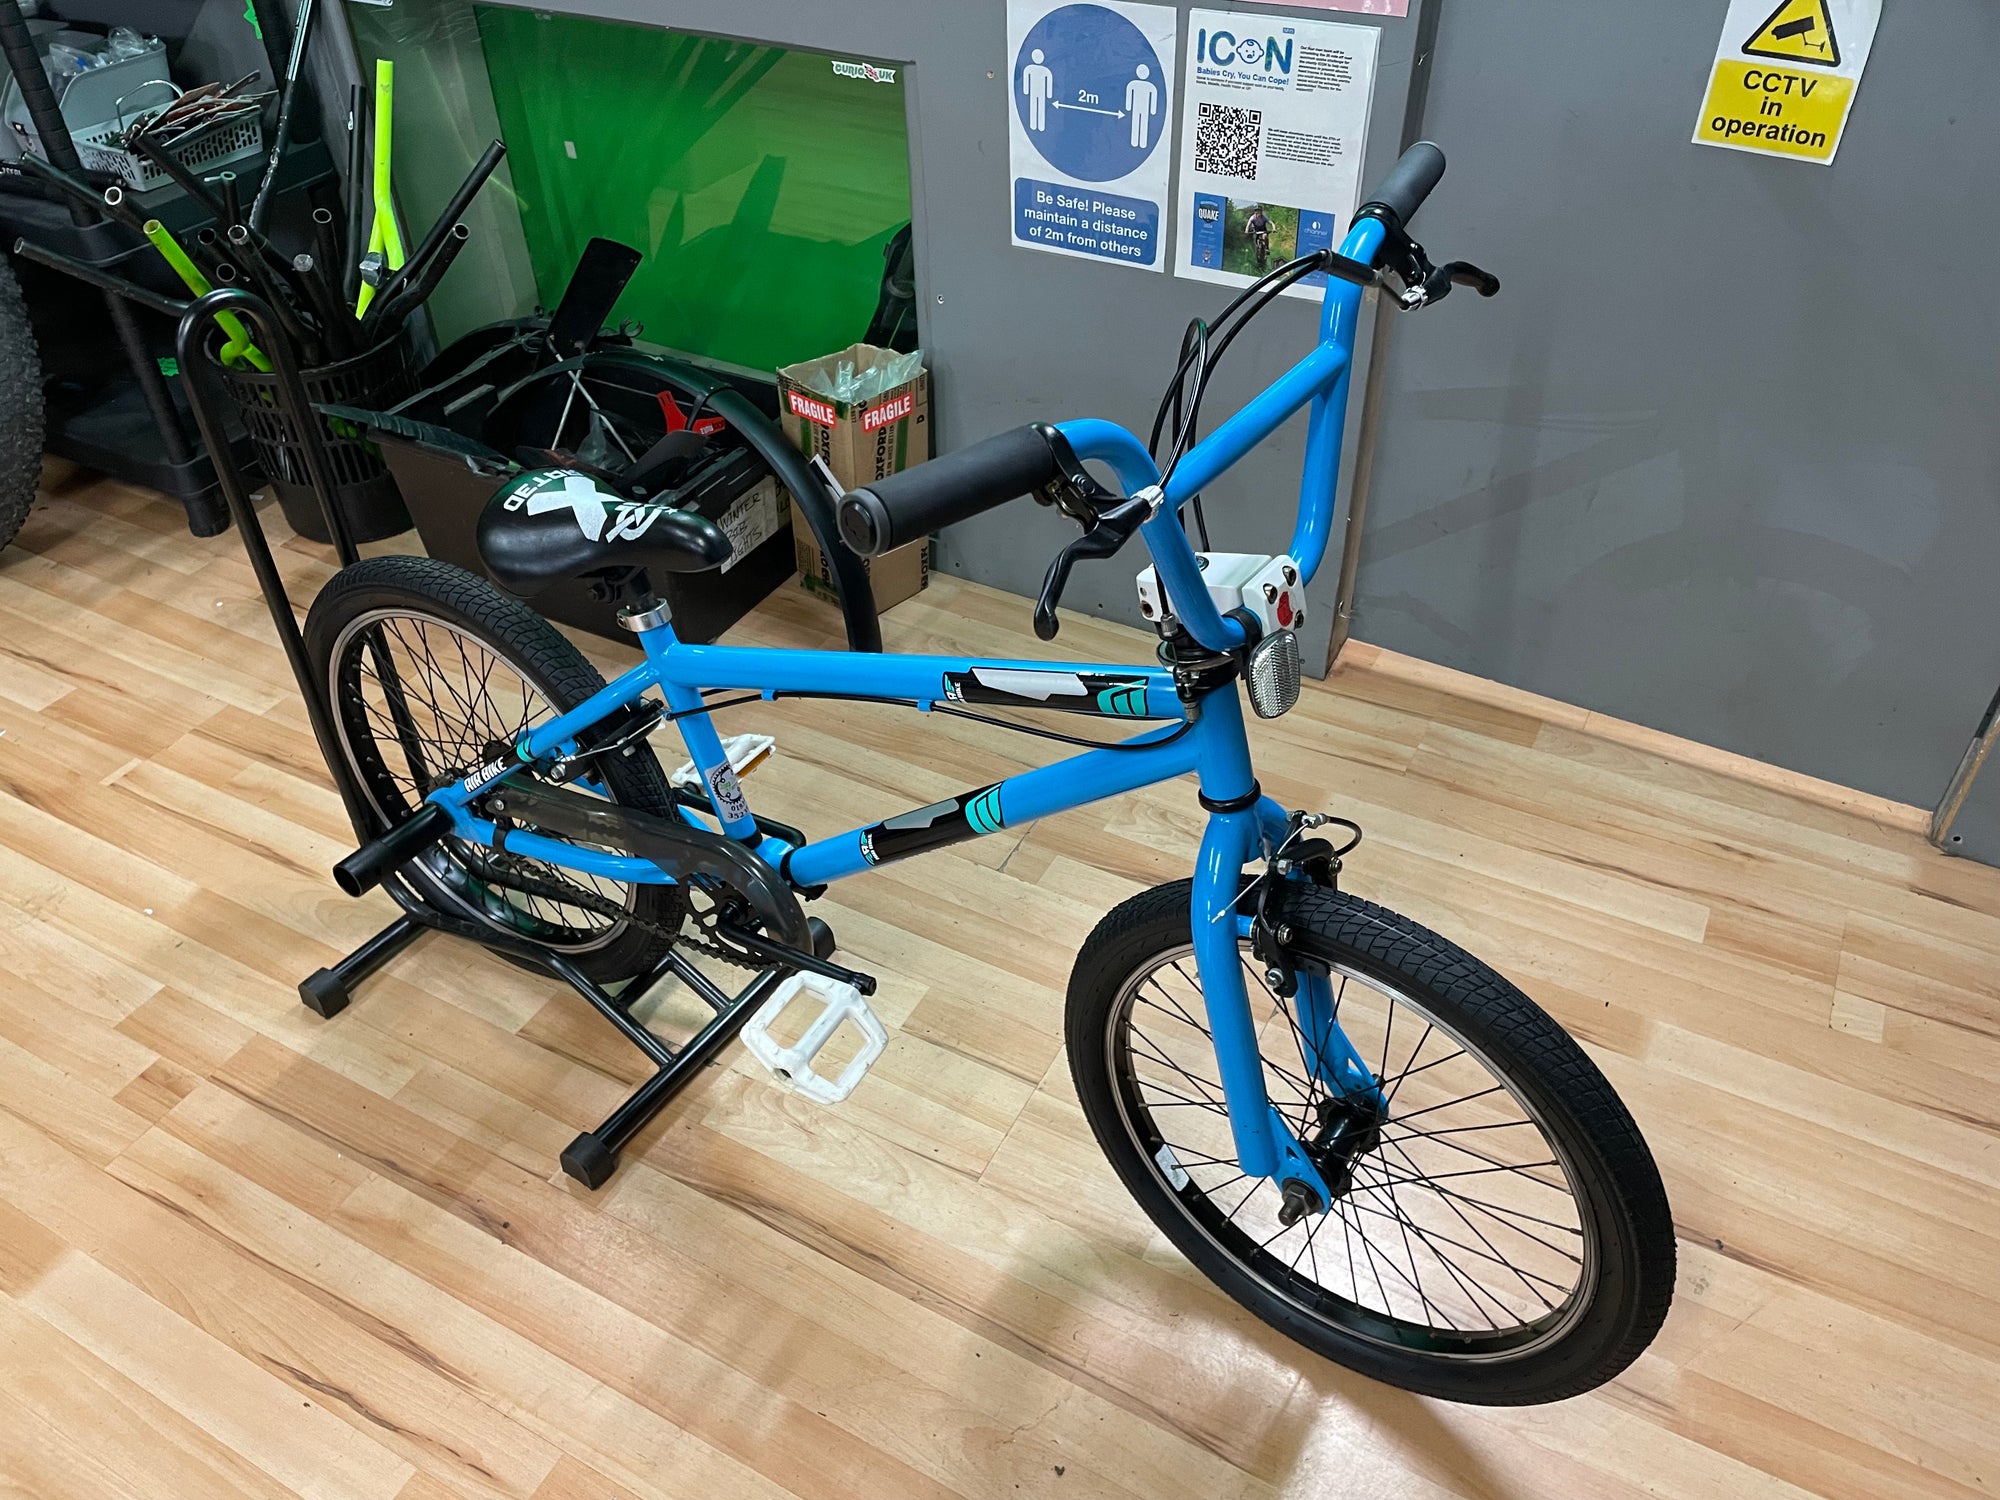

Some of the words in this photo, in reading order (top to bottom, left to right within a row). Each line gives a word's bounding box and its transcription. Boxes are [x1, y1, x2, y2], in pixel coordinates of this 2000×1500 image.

[879, 70, 893, 80] UK
[1197, 66, 1220, 76] Babies
[1222, 70, 1236, 79] Cry,
[1237, 72, 1251, 80] You
[1252, 74, 1266, 82] Can
[1267, 76, 1289, 85] Cope!
[1743, 70, 1817, 98] CCTV
[1078, 90, 1099, 105] 2m
[1759, 97, 1782, 117] in
[1711, 117, 1826, 148] operation
[1036, 190, 1053, 204] Be
[1056, 195, 1089, 211] Safe!
[1092, 201, 1136, 219] Please
[1198, 208, 1219, 221] QUAKE
[1024, 208, 1077, 227] maintain
[1081, 220, 1089, 229] a
[1092, 220, 1148, 240] distance
[1029, 226, 1042, 236] of
[1045, 228, 1064, 241] 2m
[1067, 232, 1097, 248] from
[1100, 240, 1141, 257] others
[791, 395, 834, 425] FRAGILE
[864, 400, 911, 430] FRAGILE
[820, 429, 831, 468] OXFO
[875, 427, 887, 482] OXFORD
[720, 492, 761, 530] WINTER
[464, 771, 484, 792] AIR
[481, 756, 507, 782] BIKE
